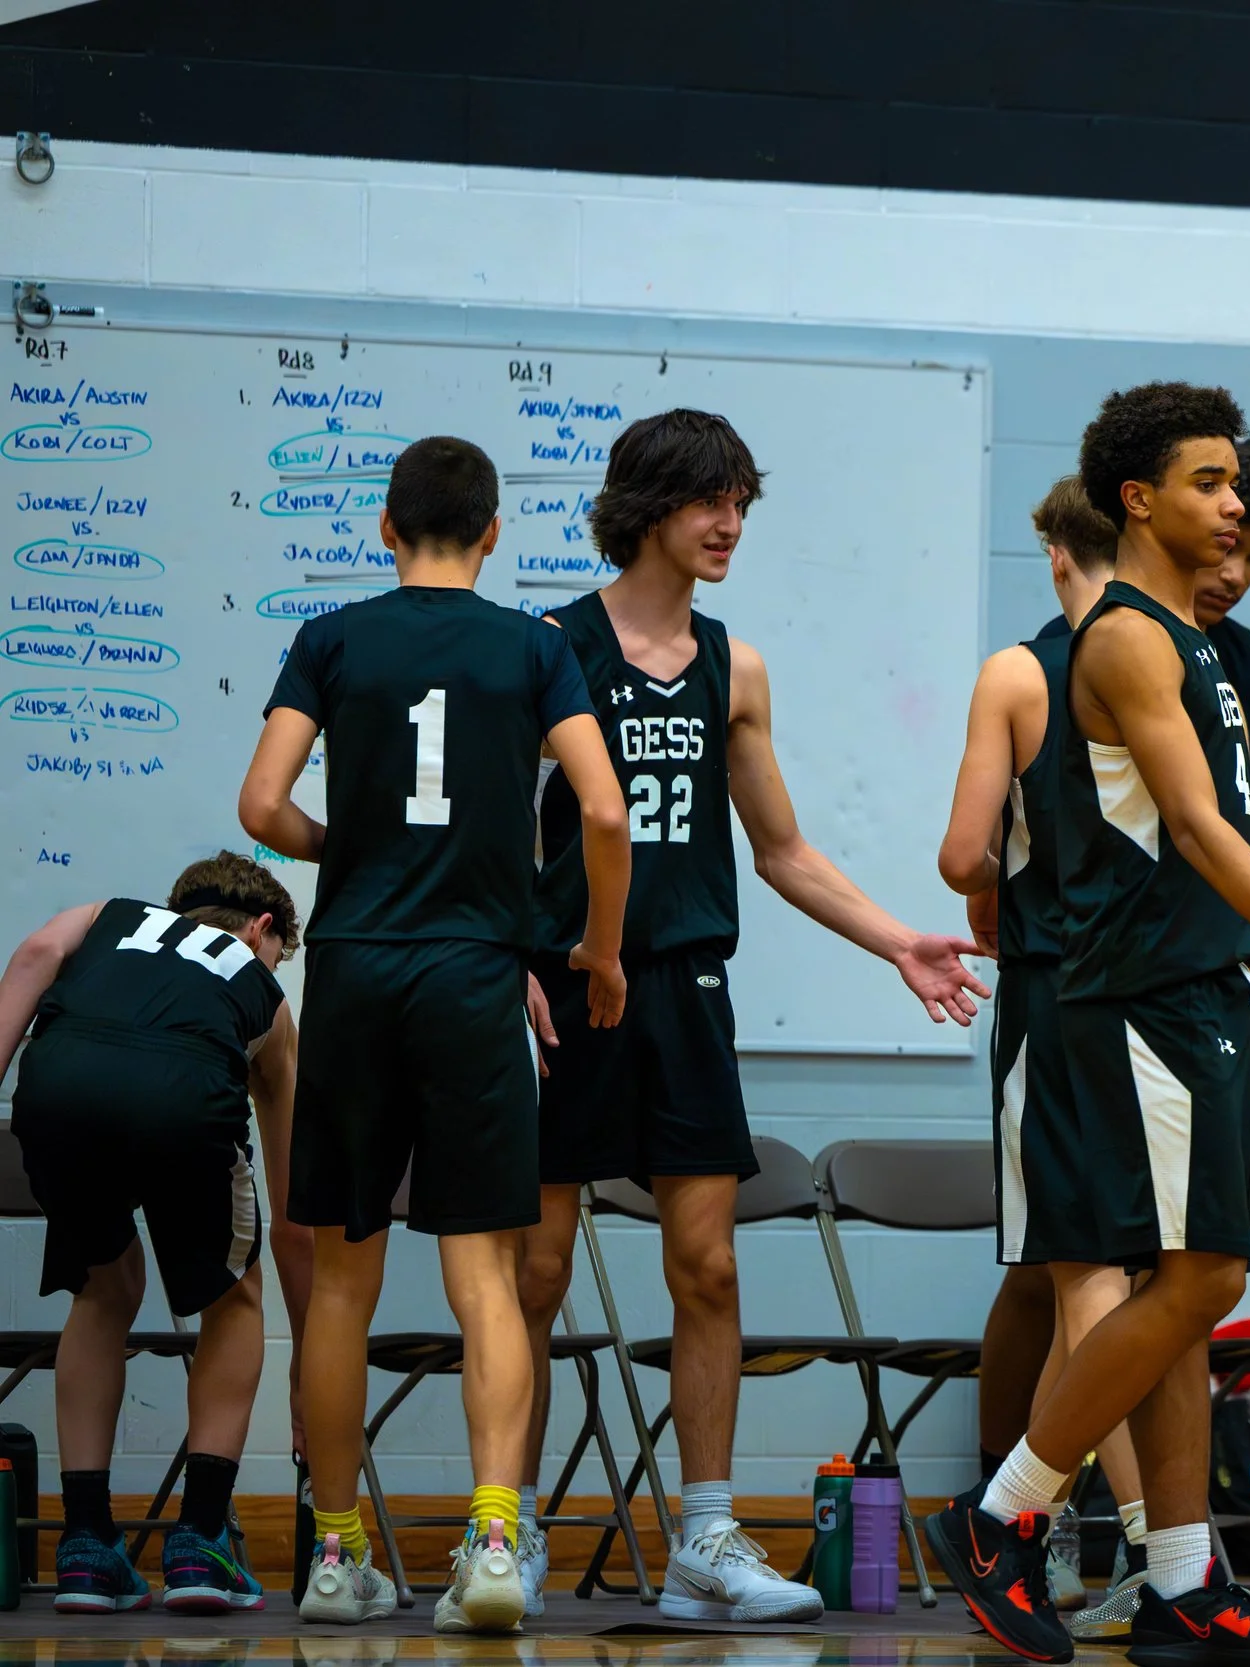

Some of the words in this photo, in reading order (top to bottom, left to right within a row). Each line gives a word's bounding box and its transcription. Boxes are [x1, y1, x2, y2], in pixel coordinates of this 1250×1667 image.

[406, 688, 451, 826] 1
[620, 717, 705, 762] GESS
[629, 774, 693, 843] 22
[814, 1497, 838, 1532] G
